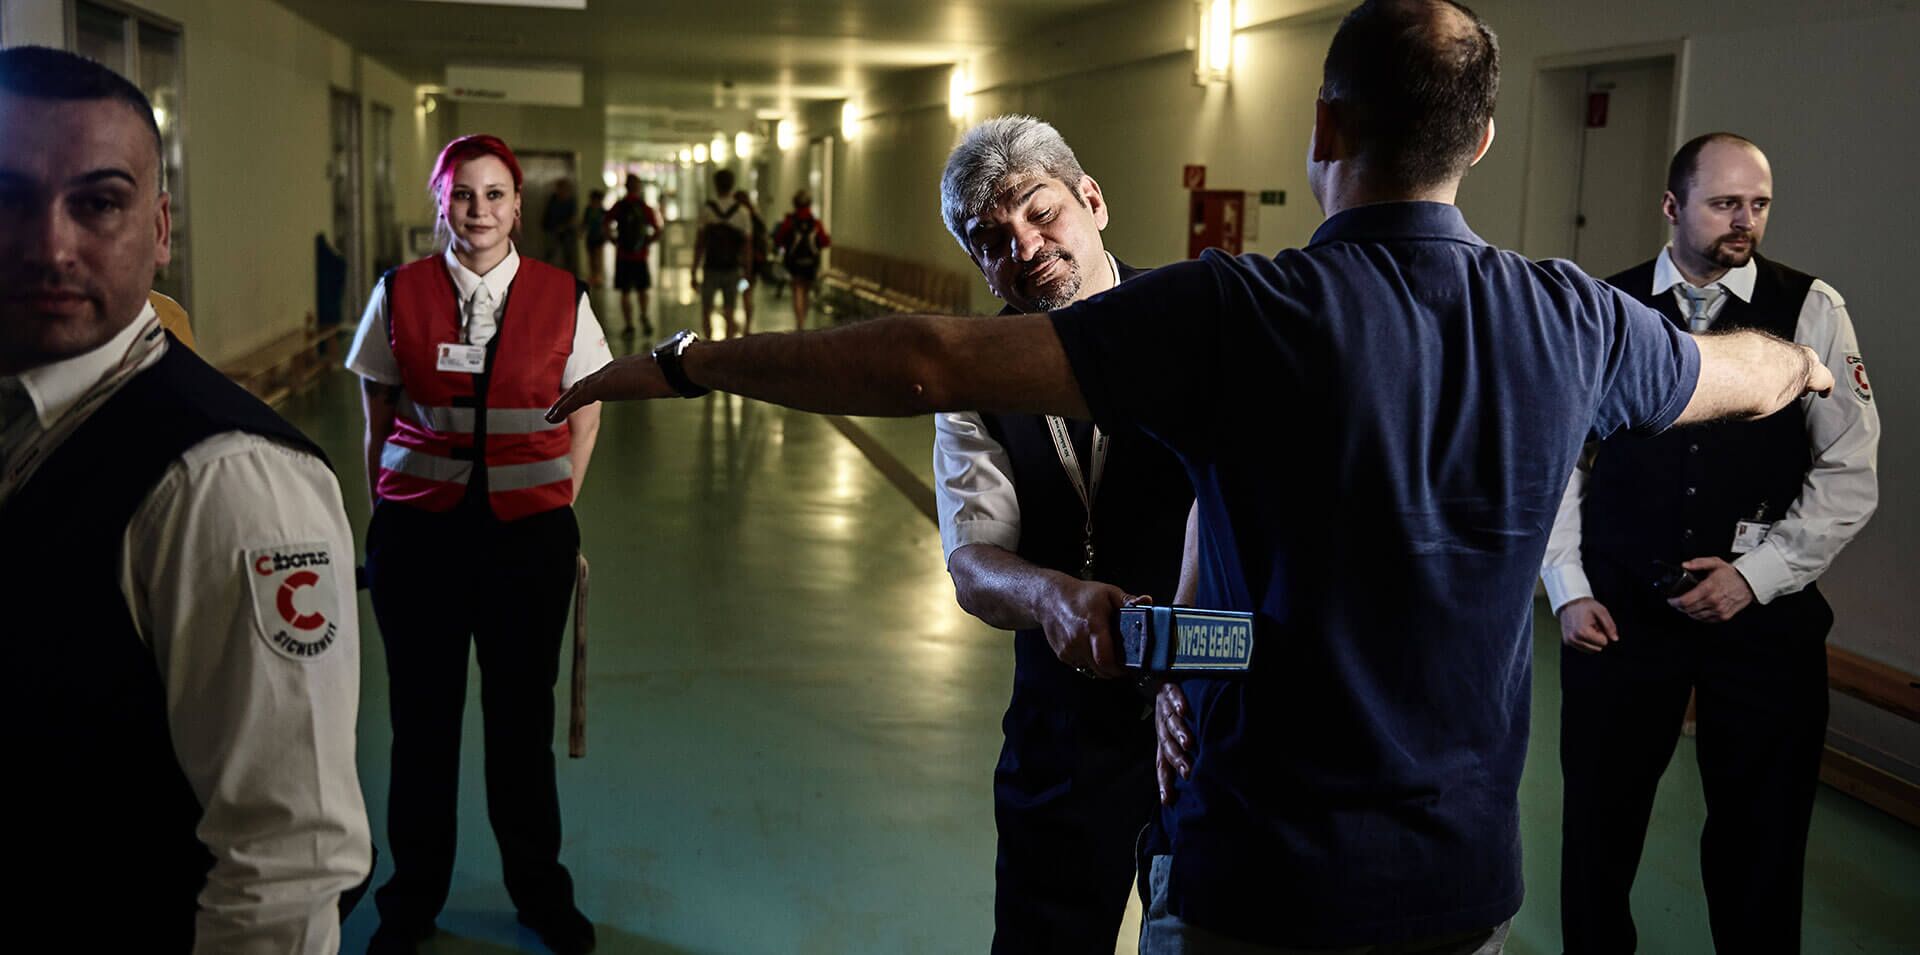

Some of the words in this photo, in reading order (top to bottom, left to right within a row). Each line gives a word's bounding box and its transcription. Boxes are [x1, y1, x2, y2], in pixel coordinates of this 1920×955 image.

[276, 570, 326, 631] C
[273, 622, 338, 656] SICHERHEIT
[1208, 625, 1246, 659] SUPER
